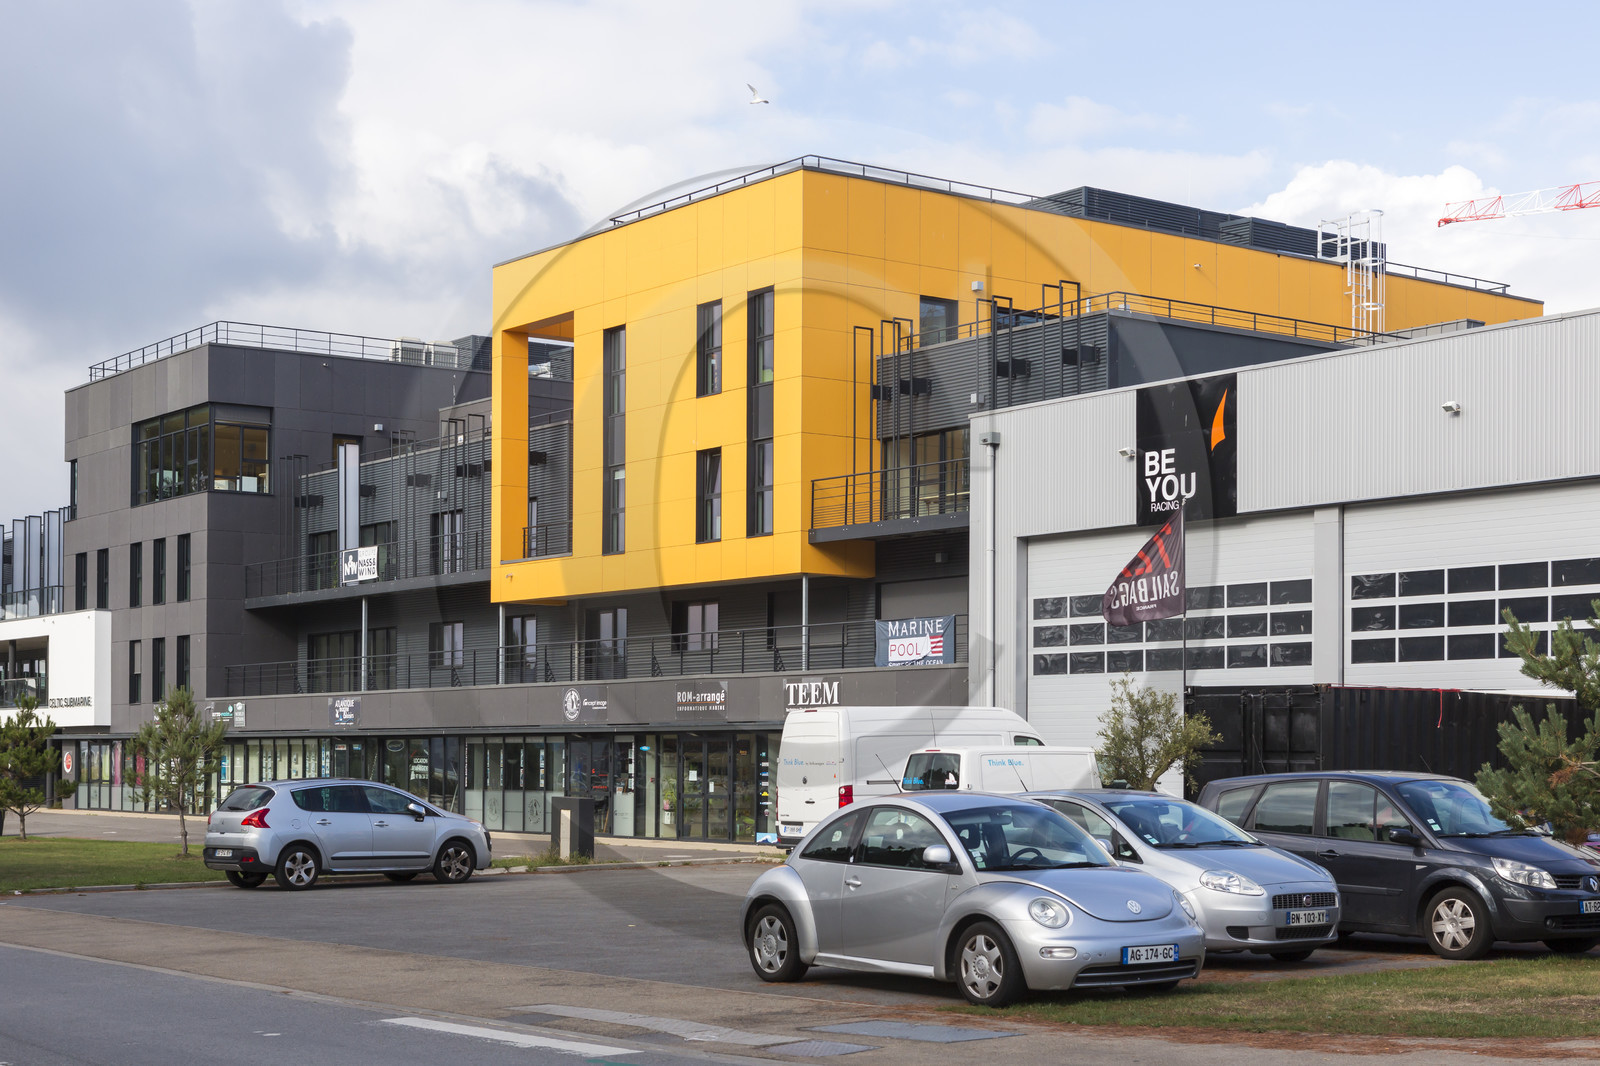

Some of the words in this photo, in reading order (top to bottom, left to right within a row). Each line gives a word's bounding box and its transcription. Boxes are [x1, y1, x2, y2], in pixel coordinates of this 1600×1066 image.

[1145, 448, 1176, 477] BE
[1145, 472, 1196, 502] YOU
[1151, 500, 1180, 512] RACING
[359, 567, 376, 576] WIND
[888, 619, 944, 637] MARINE
[889, 643, 922, 657] POOL
[677, 690, 725, 704] ROM-arrangé
[786, 681, 840, 706] TEEM
[49, 698, 64, 708] CELTIC
[64, 696, 92, 707] SUBMARINE
[988, 759, 1006, 767] Think
[1130, 947, 1173, 961] AG-174-GC
